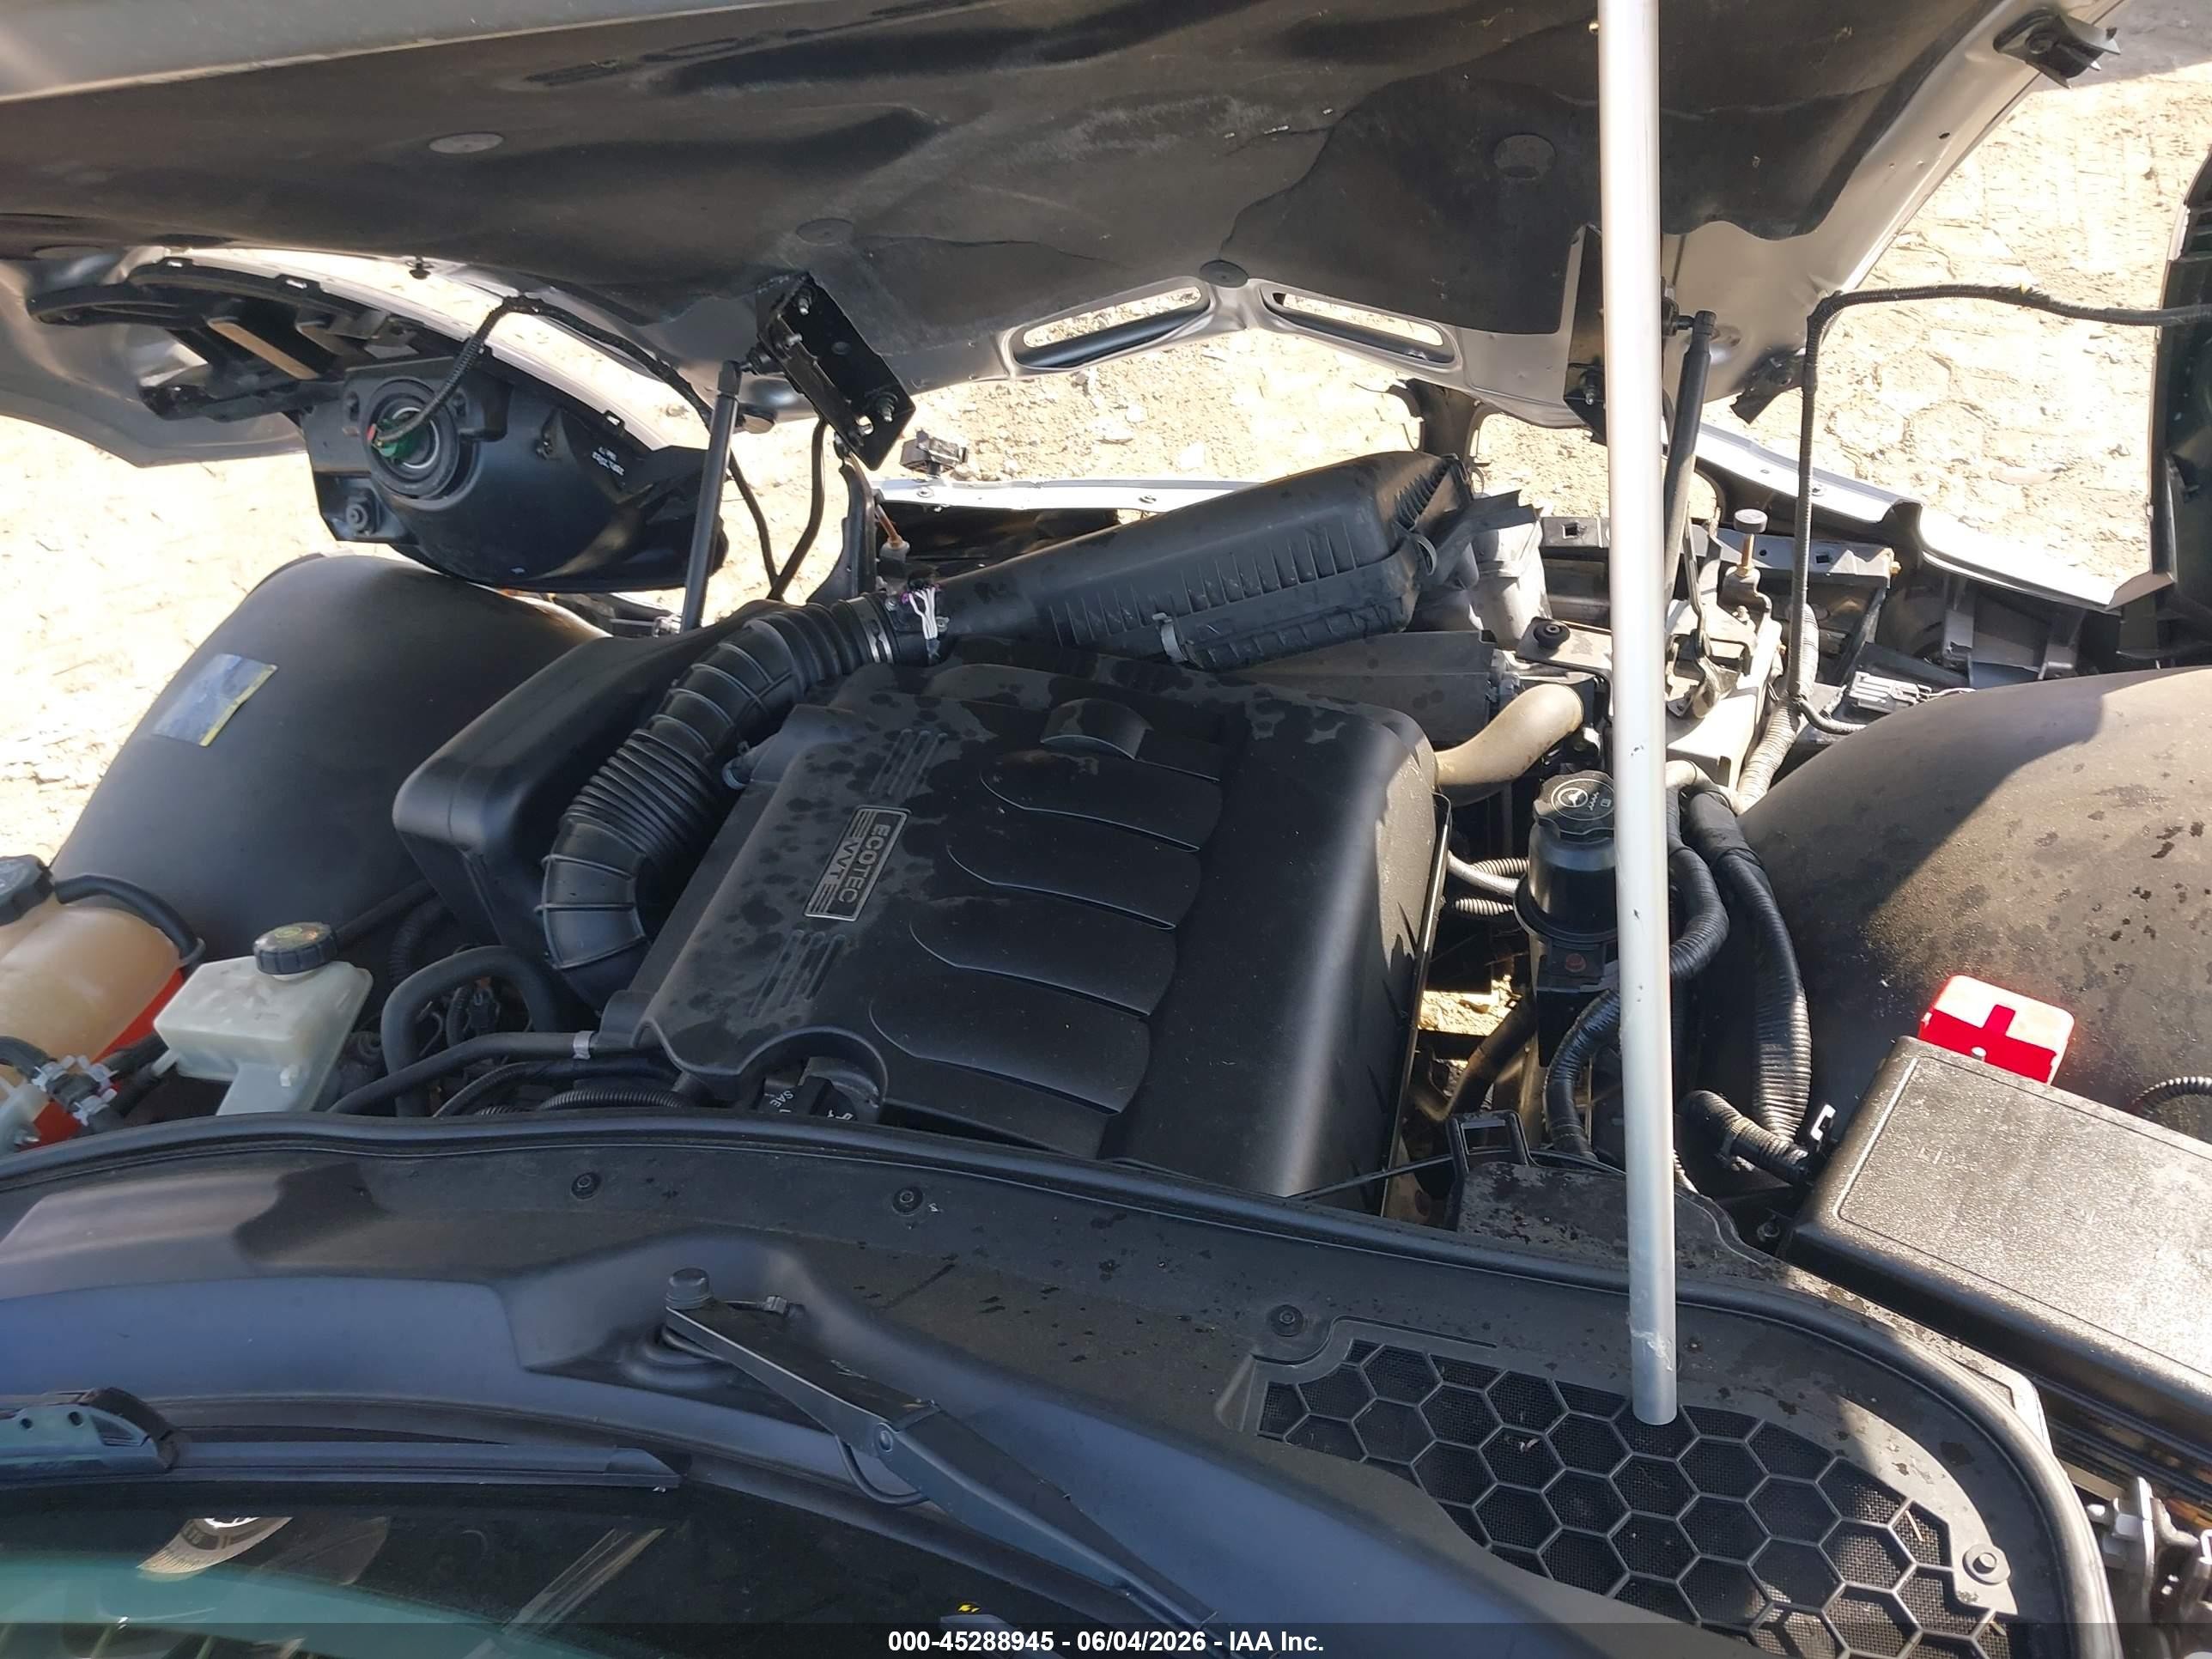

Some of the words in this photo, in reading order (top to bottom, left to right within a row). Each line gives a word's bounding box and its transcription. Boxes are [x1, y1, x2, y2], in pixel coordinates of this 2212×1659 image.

[830, 841, 860, 880] VVT
[837, 823, 891, 903] ECOTEC
[769, 1090, 794, 1108] SAE
